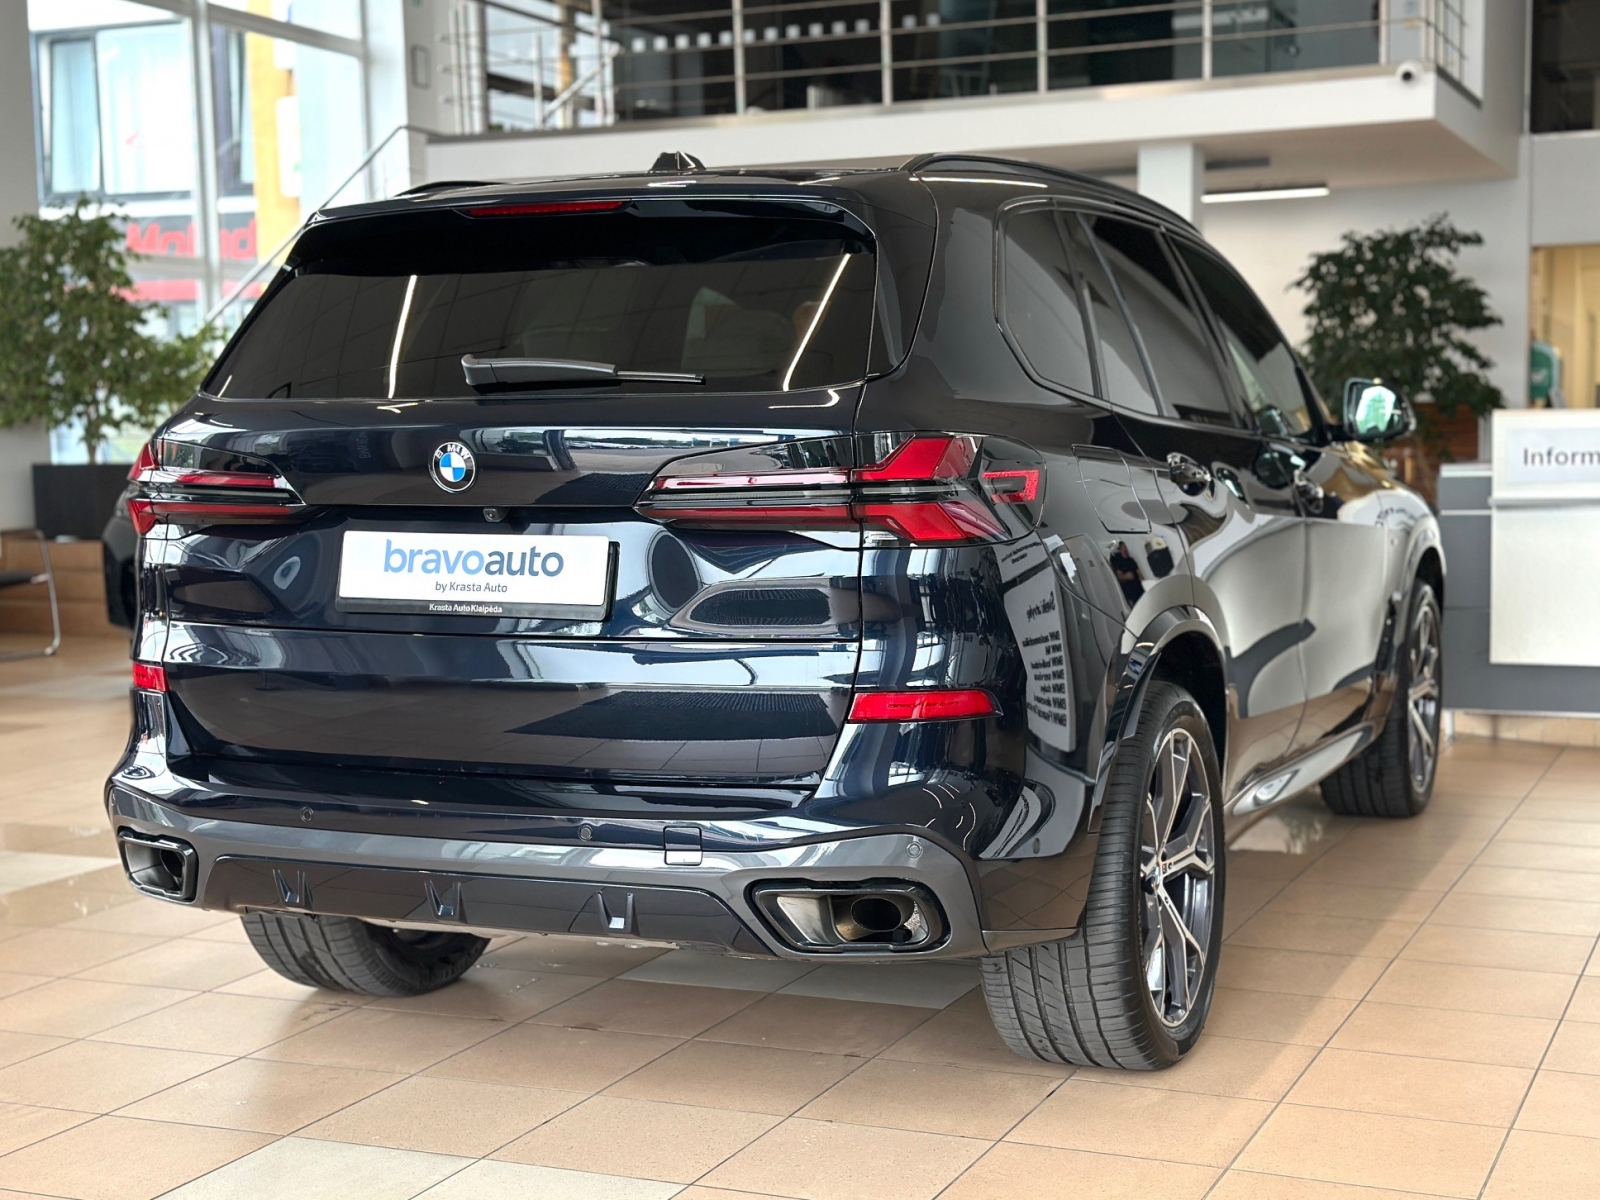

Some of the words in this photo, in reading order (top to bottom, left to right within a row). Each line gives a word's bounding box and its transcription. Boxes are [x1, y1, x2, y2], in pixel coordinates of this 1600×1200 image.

[434, 444, 471, 459] BMW
[1523, 446, 1600, 466] Inform
[384, 538, 565, 577] bravoauto
[435, 581, 447, 593] by
[449, 581, 482, 592] Krasta
[483, 582, 508, 593] Auto
[429, 603, 452, 612] Krasta
[452, 603, 471, 612] Auto
